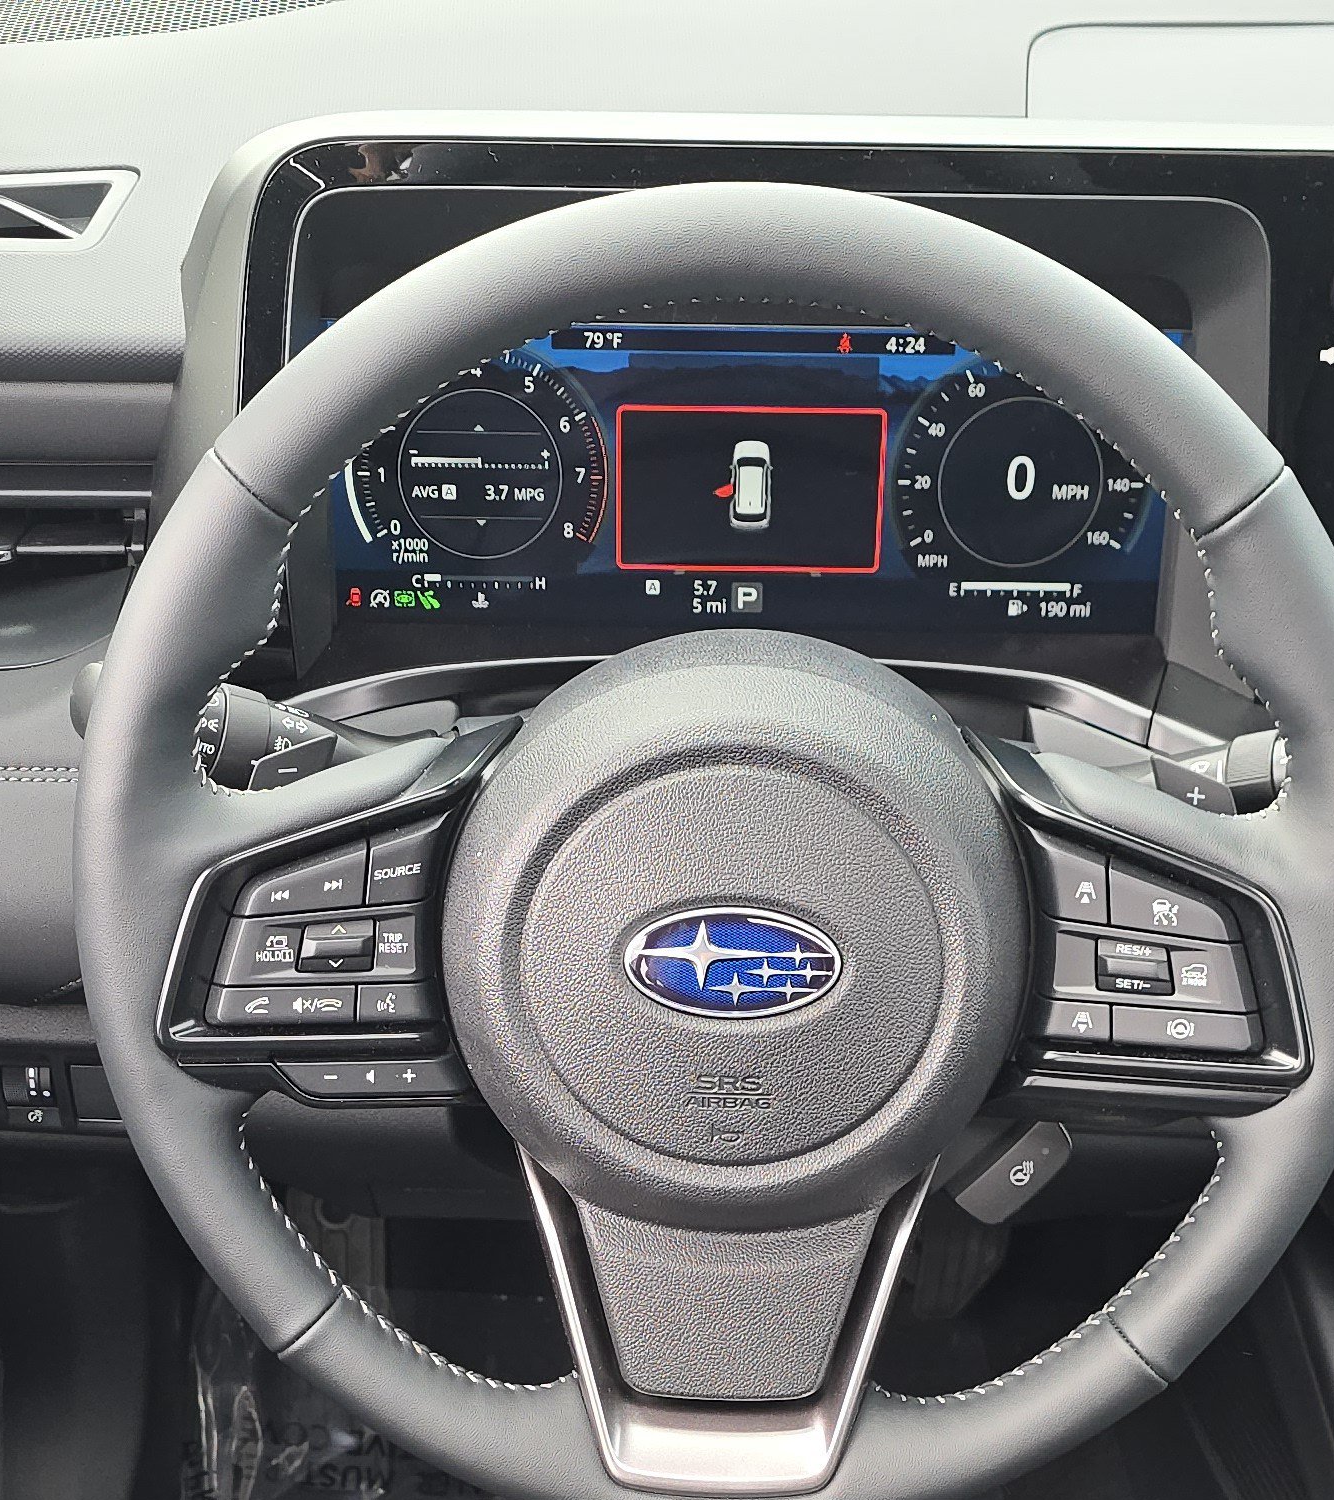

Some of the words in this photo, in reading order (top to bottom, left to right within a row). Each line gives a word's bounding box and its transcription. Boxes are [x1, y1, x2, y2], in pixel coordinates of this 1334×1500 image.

[583, 332, 622, 349] 79°F
[886, 336, 926, 354] 4:24
[524, 377, 535, 393] 5
[968, 382, 985, 398] 60
[560, 417, 570, 433] 6
[928, 423, 946, 438] 40
[378, 468, 385, 483] 1
[575, 469, 585, 484] 7
[914, 475, 931, 490] 20
[1007, 455, 1036, 501] 0
[1052, 484, 1089, 501] MPH
[1107, 478, 1130, 493] 140
[412, 486, 439, 500] AVG
[485, 486, 509, 501] 3.7
[514, 488, 545, 502] MPG
[390, 520, 401, 535] 0
[563, 522, 574, 538] 8
[923, 529, 933, 544] 0
[1087, 530, 1110, 546] 160
[393, 551, 428, 564] r/min
[917, 553, 948, 568] MPH
[412, 575, 421, 587] C
[535, 577, 546, 590] H
[647, 581, 659, 594] A
[693, 580, 717, 595] 5.7
[737, 587, 757, 609] P
[949, 584, 958, 597] E
[1073, 584, 1082, 598] F
[692, 598, 702, 613] 5
[706, 598, 727, 613] mi
[1039, 602, 1067, 619] 190
[1069, 602, 1091, 618] mi
[373, 863, 421, 880] SOURCE
[383, 933, 402, 944] TRIP
[379, 943, 408, 954] RESET
[1116, 945, 1152, 957] RES/+
[256, 951, 281, 962] HOLD
[695, 1075, 762, 1093] SRS
[686, 1098, 772, 1111] AIRBAG
